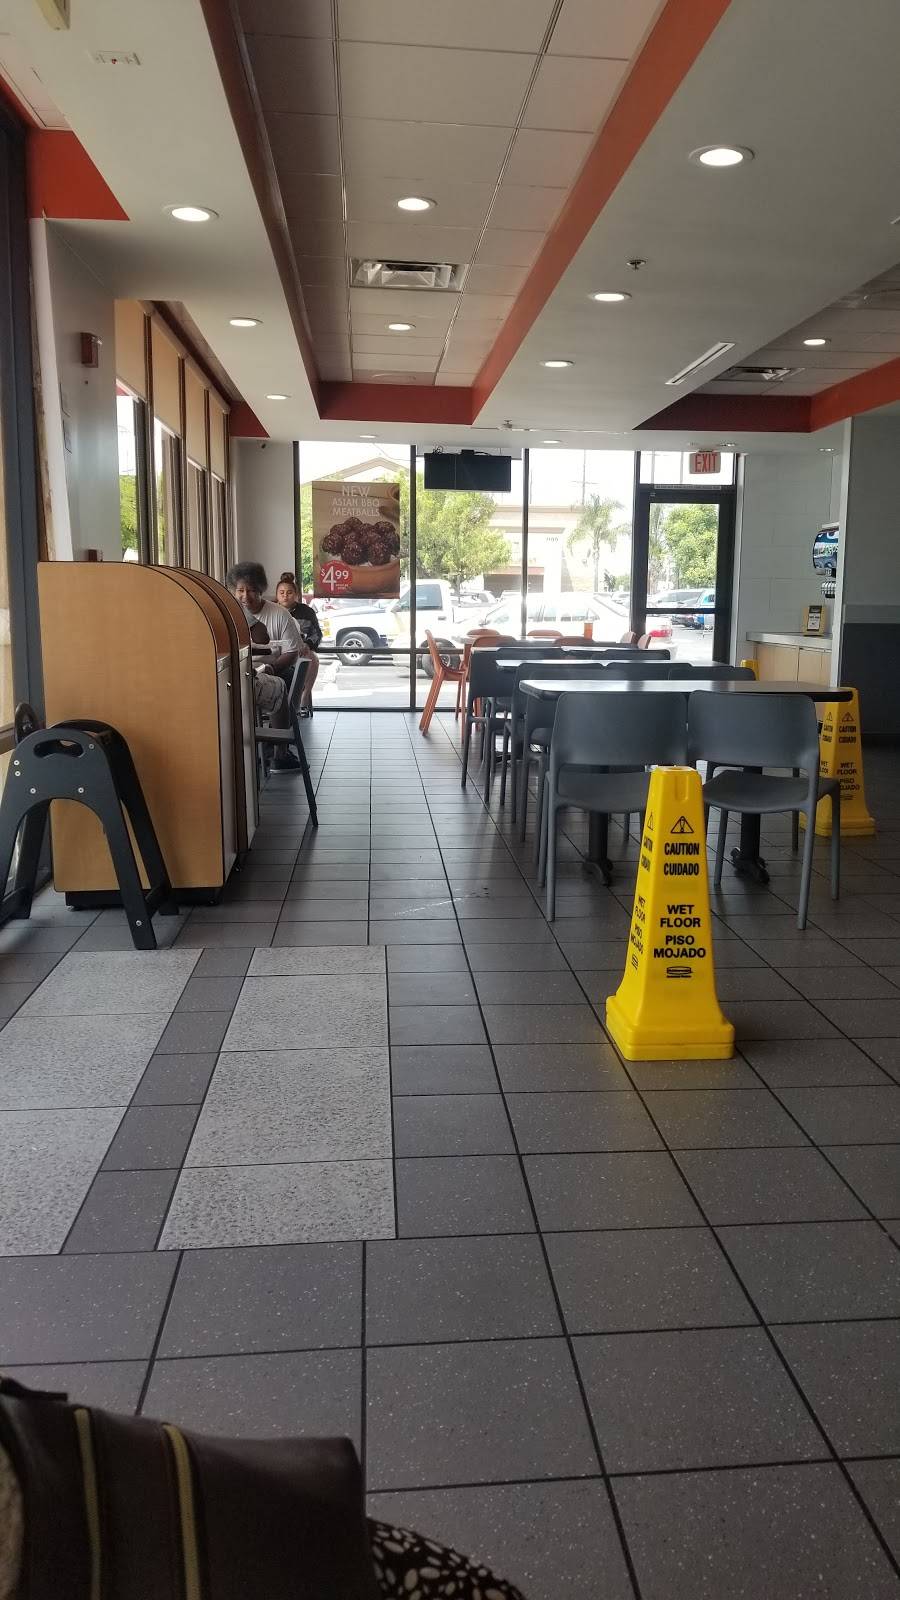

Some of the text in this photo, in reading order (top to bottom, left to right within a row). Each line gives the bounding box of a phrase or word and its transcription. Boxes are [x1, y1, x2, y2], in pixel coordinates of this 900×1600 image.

[695, 454, 717, 472] EXIT
[342, 485, 370, 497] NEW
[332, 499, 379, 508] ASIAN BBQ
[332, 508, 379, 517] MEATBALLS
[664, 842, 700, 856] CAUTION
[663, 862, 699, 876] CUIDADO
[667, 904, 694, 915] WET
[660, 917, 701, 928] FLOOR
[665, 935, 694, 945] PISO
[653, 948, 706, 958] MOJADO
